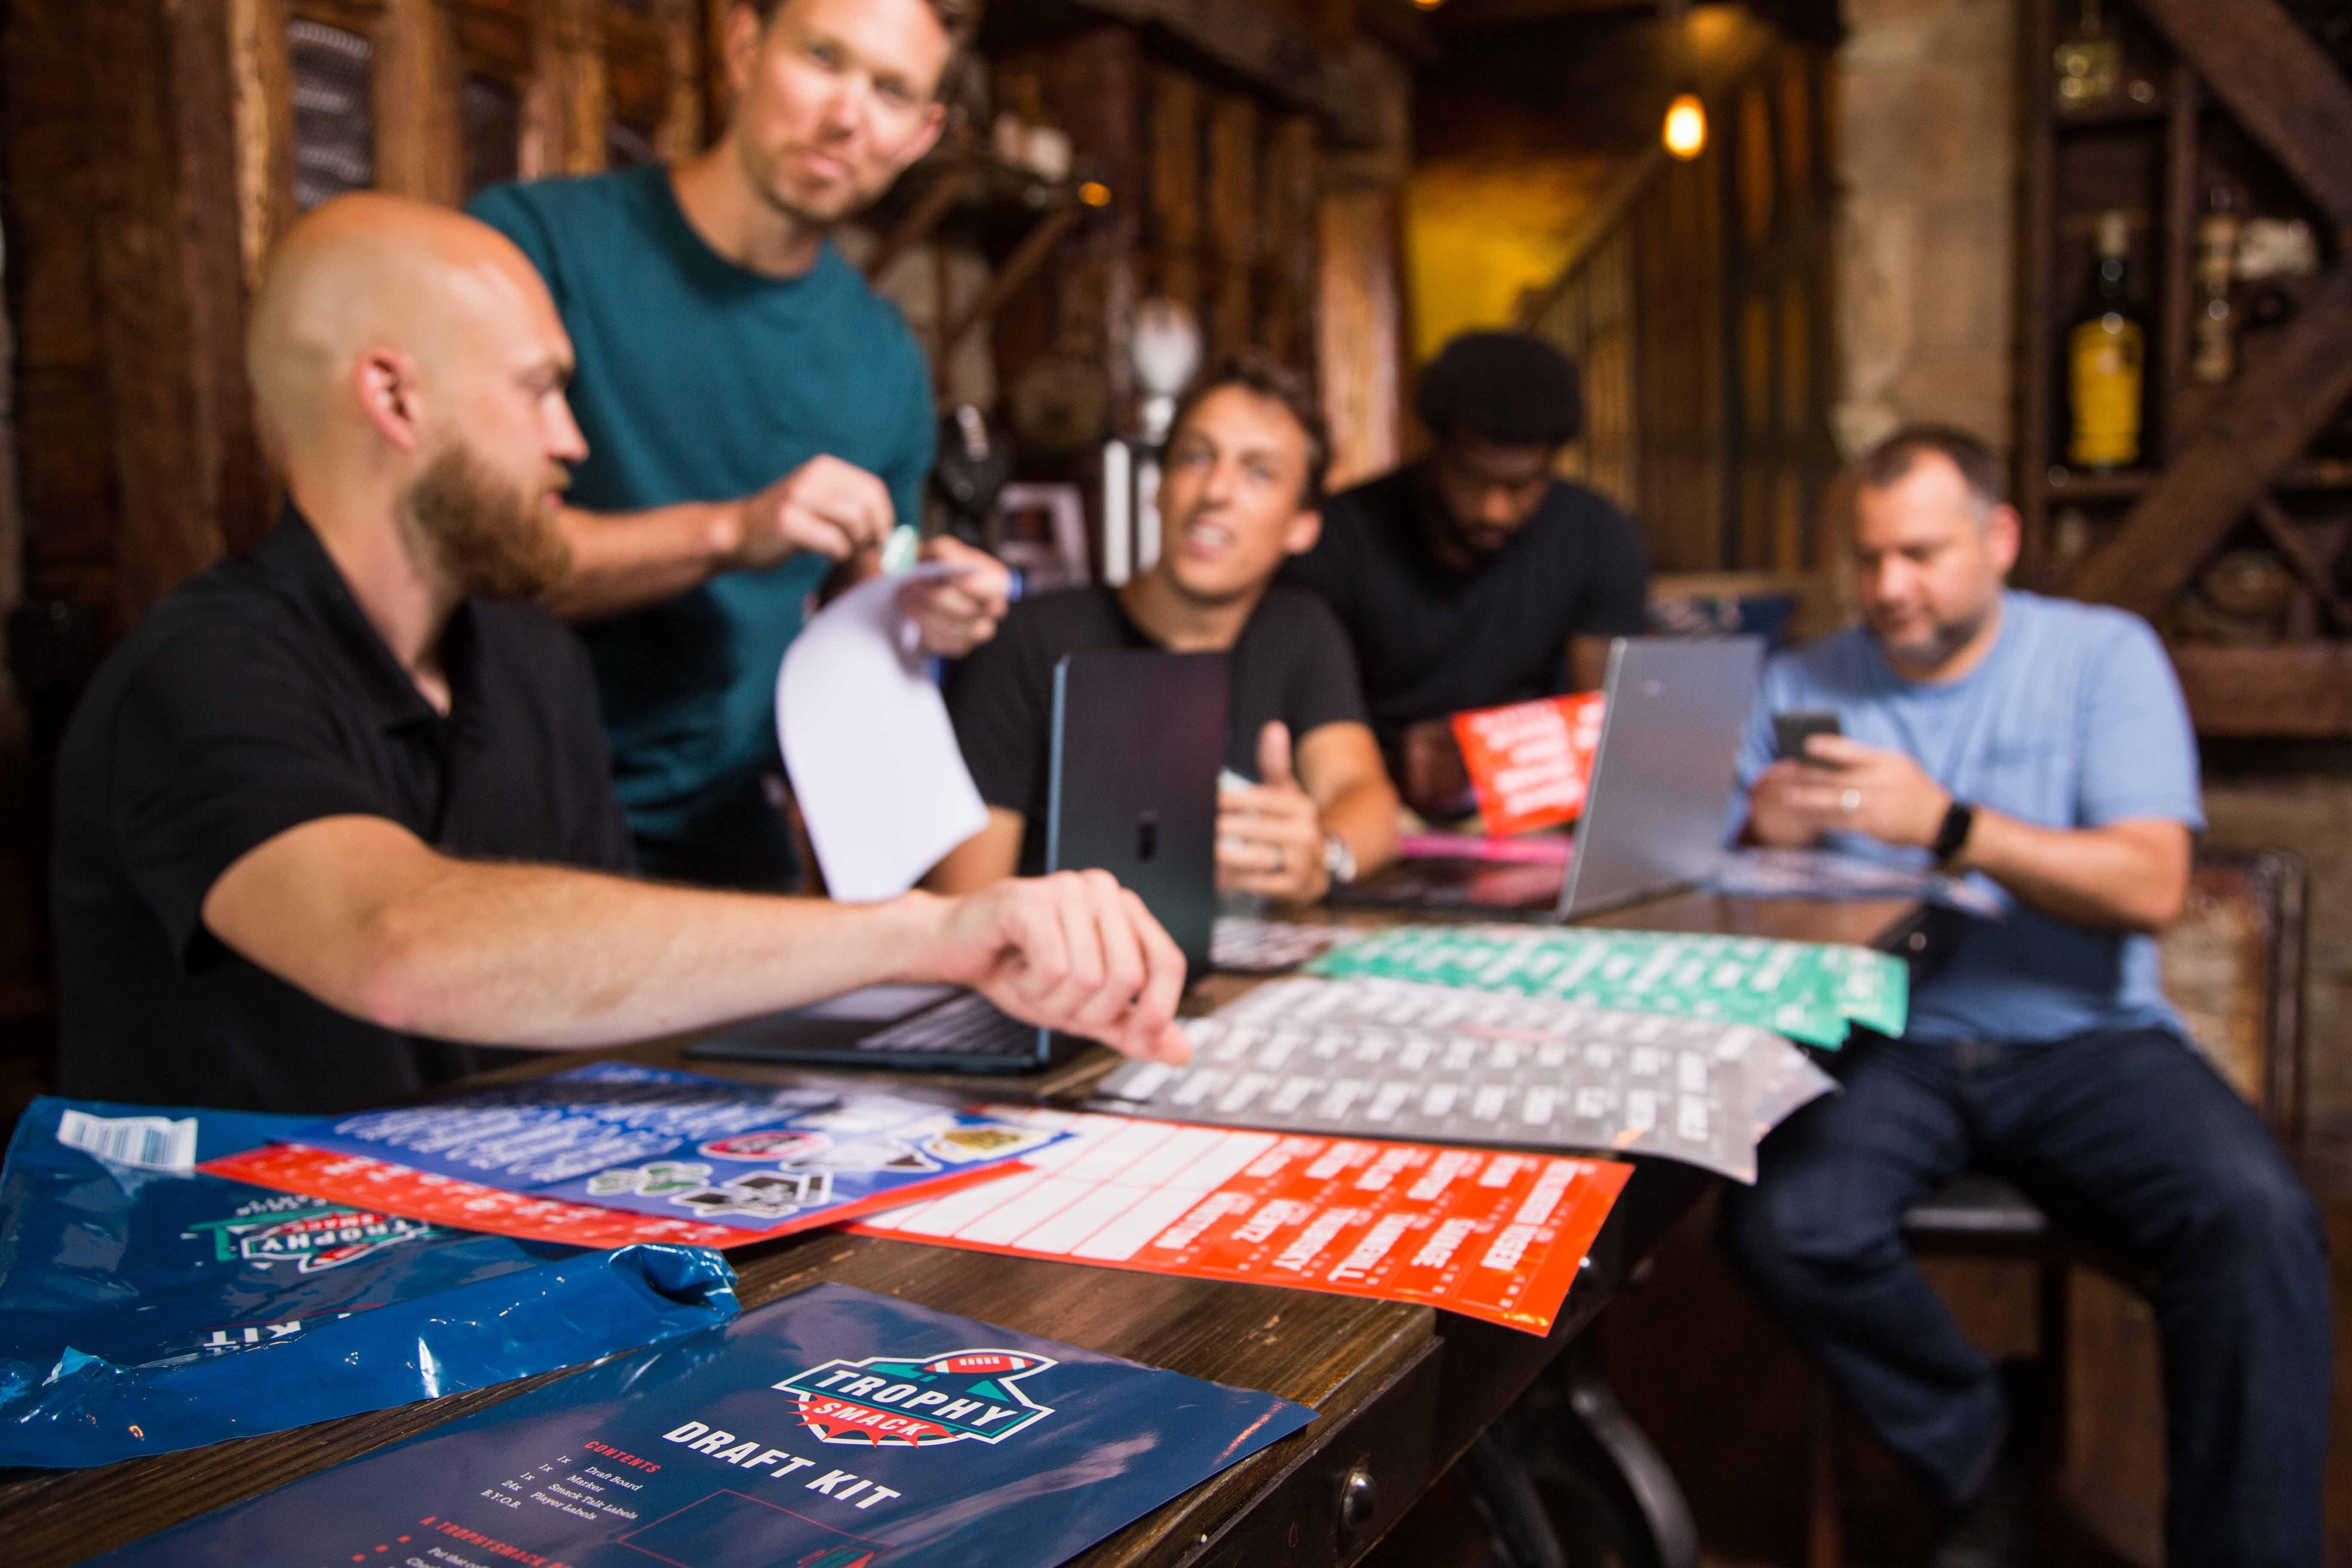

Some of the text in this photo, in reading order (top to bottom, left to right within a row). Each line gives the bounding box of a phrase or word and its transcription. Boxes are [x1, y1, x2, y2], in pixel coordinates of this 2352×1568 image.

[260, 1219, 410, 1251] TROPHY
[815, 1370, 1019, 1427] TROPHY
[814, 1401, 932, 1436] SMACK
[557, 1455, 643, 1491] 1x Draft Board
[584, 1441, 662, 1473] CONTENTS
[662, 1421, 902, 1510] DRAFT KIT
[501, 1480, 597, 1520] 24x Player Labels
[548, 1483, 584, 1501] Smack
[582, 1495, 605, 1509] Talk
[602, 1503, 639, 1519] Labels
[567, 1475, 605, 1492] Marker
